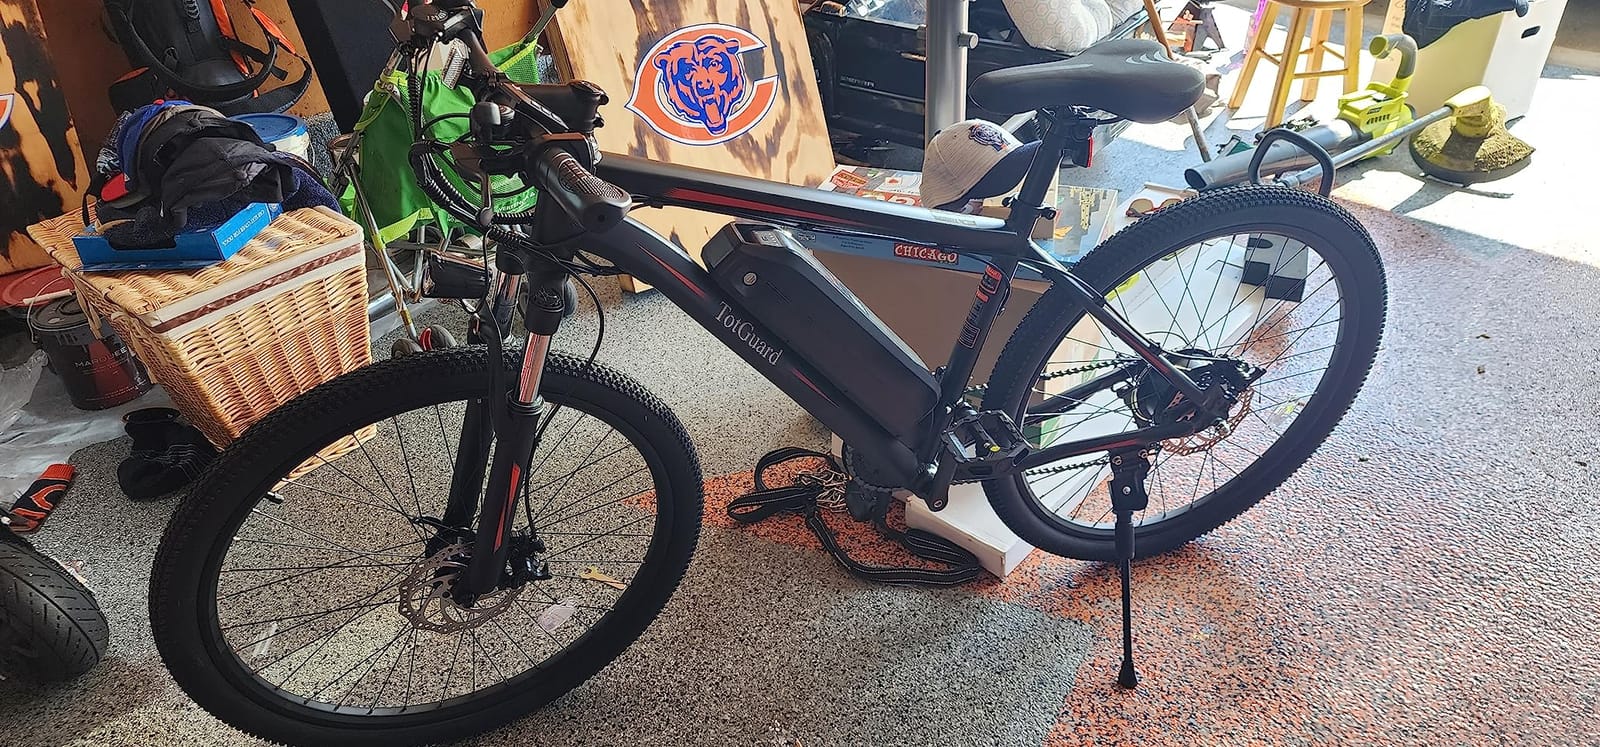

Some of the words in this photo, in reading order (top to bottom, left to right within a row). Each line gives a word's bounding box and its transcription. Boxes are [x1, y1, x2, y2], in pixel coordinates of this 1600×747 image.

[895, 244, 958, 263] CHICAGO
[714, 301, 784, 366] TotGuard
[74, 346, 128, 368] MARQUEE
